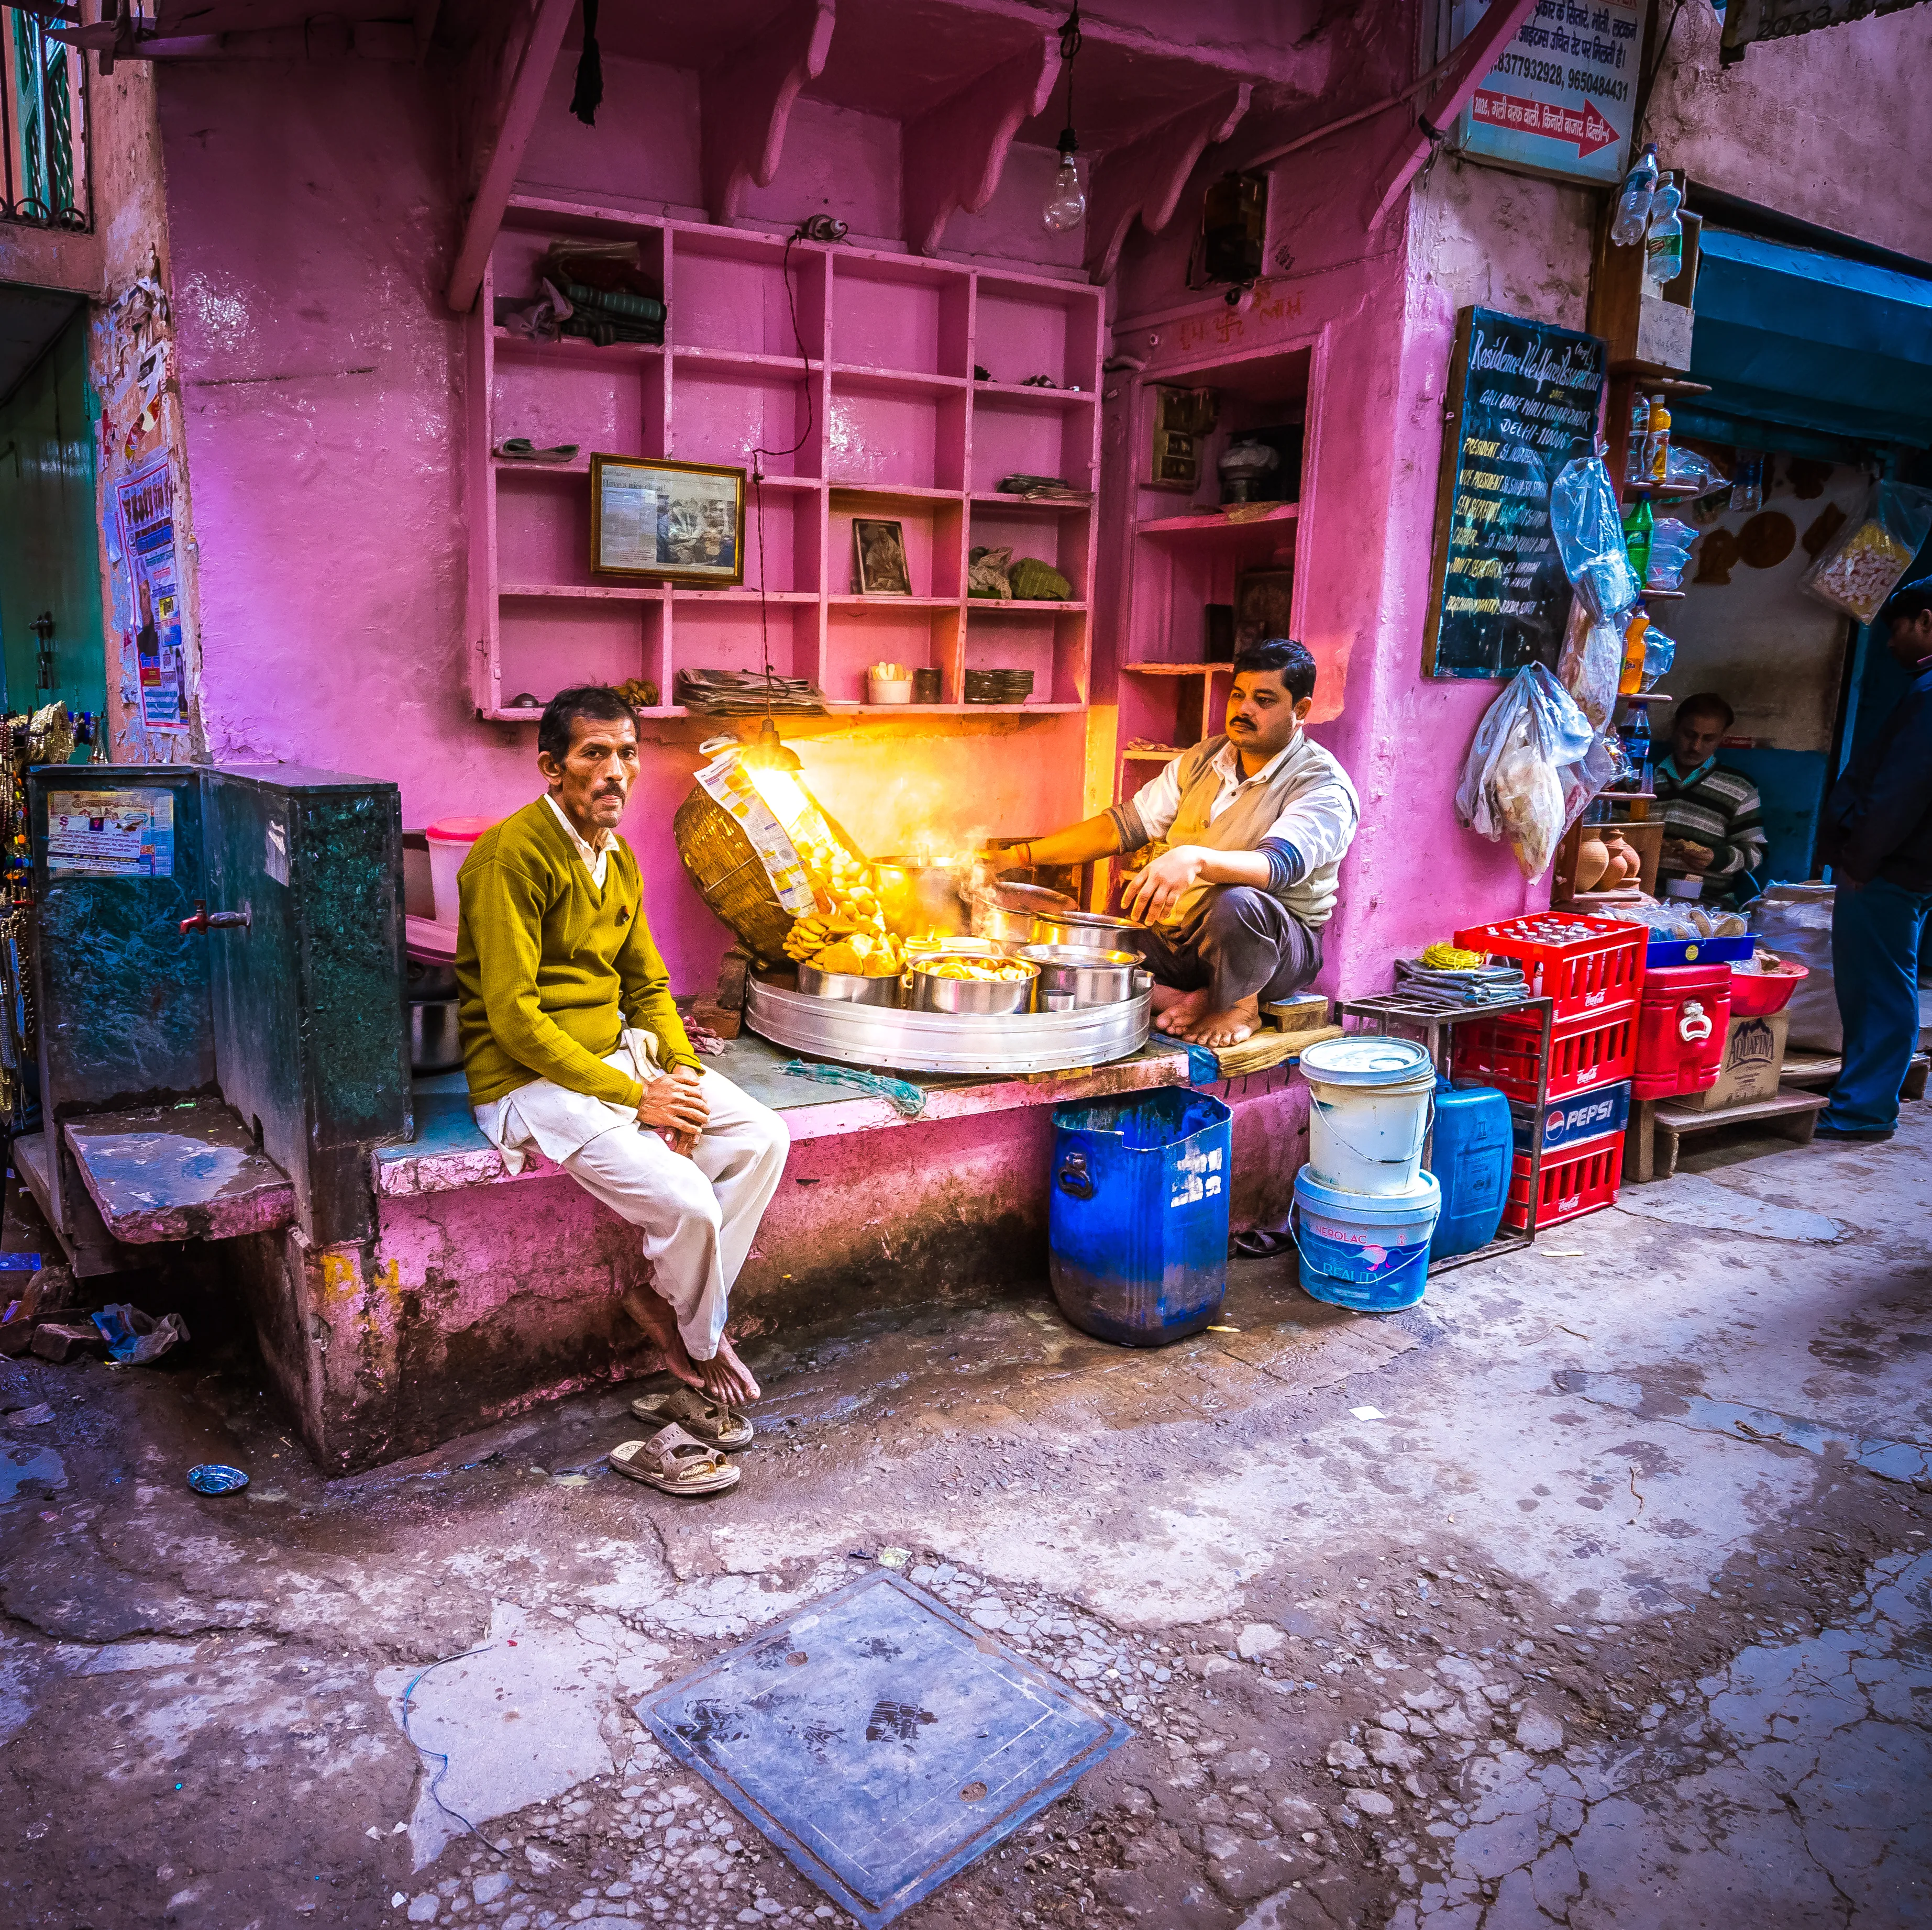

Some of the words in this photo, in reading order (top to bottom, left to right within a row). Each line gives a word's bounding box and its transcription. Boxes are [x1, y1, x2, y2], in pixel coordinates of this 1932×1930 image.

[1582, 40, 1593, 59] पर
[1567, 68, 1629, 102] 9650484431
[1492, 96, 1507, 119] गली
[1479, 389, 1502, 407] GALI
[1499, 394, 1525, 412] BARF
[1521, 398, 1544, 418] WALI
[1726, 1029, 1775, 1069] AQUAFINA
[1566, 1099, 1614, 1130] PEPSI
[1316, 1226, 1367, 1244] NEROLAC
[1323, 1262, 1383, 1286] REALITY
